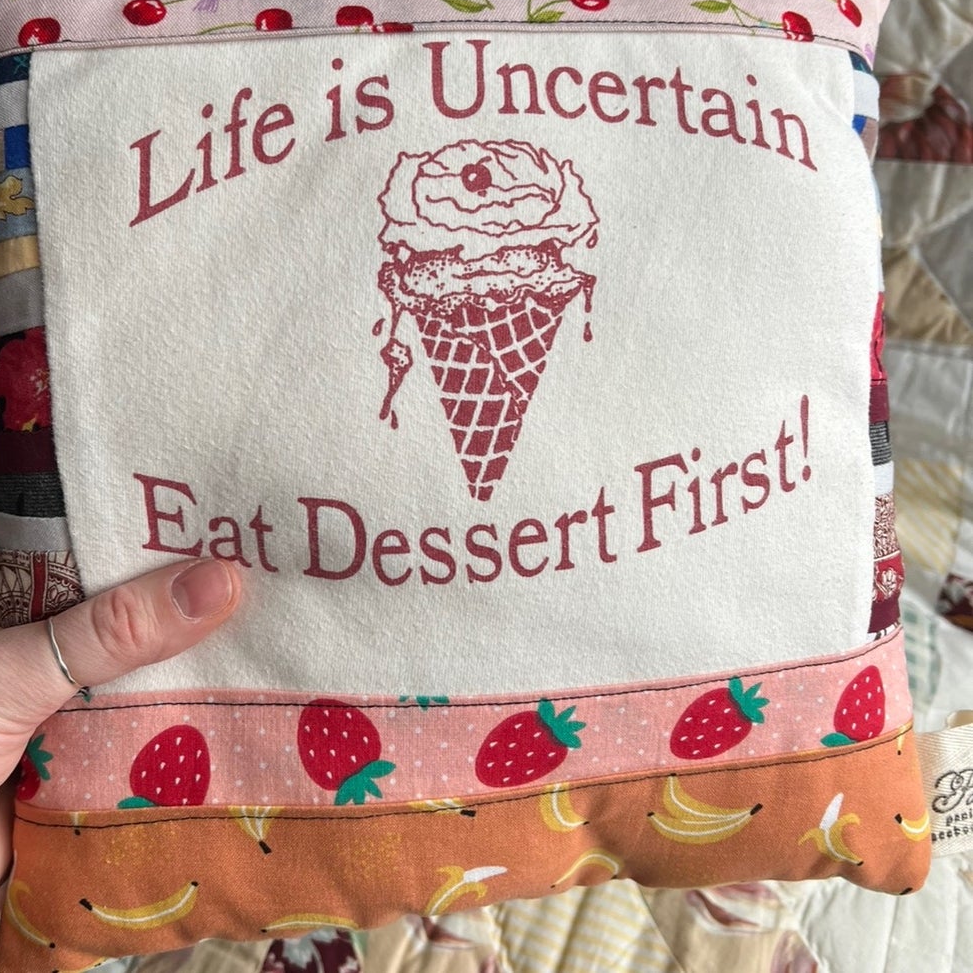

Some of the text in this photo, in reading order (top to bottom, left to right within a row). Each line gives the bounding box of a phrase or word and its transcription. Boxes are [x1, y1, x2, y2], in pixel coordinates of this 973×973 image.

[128, 39, 818, 228] Life is Uncertain
[133, 395, 814, 586] Eat Dessert First!
